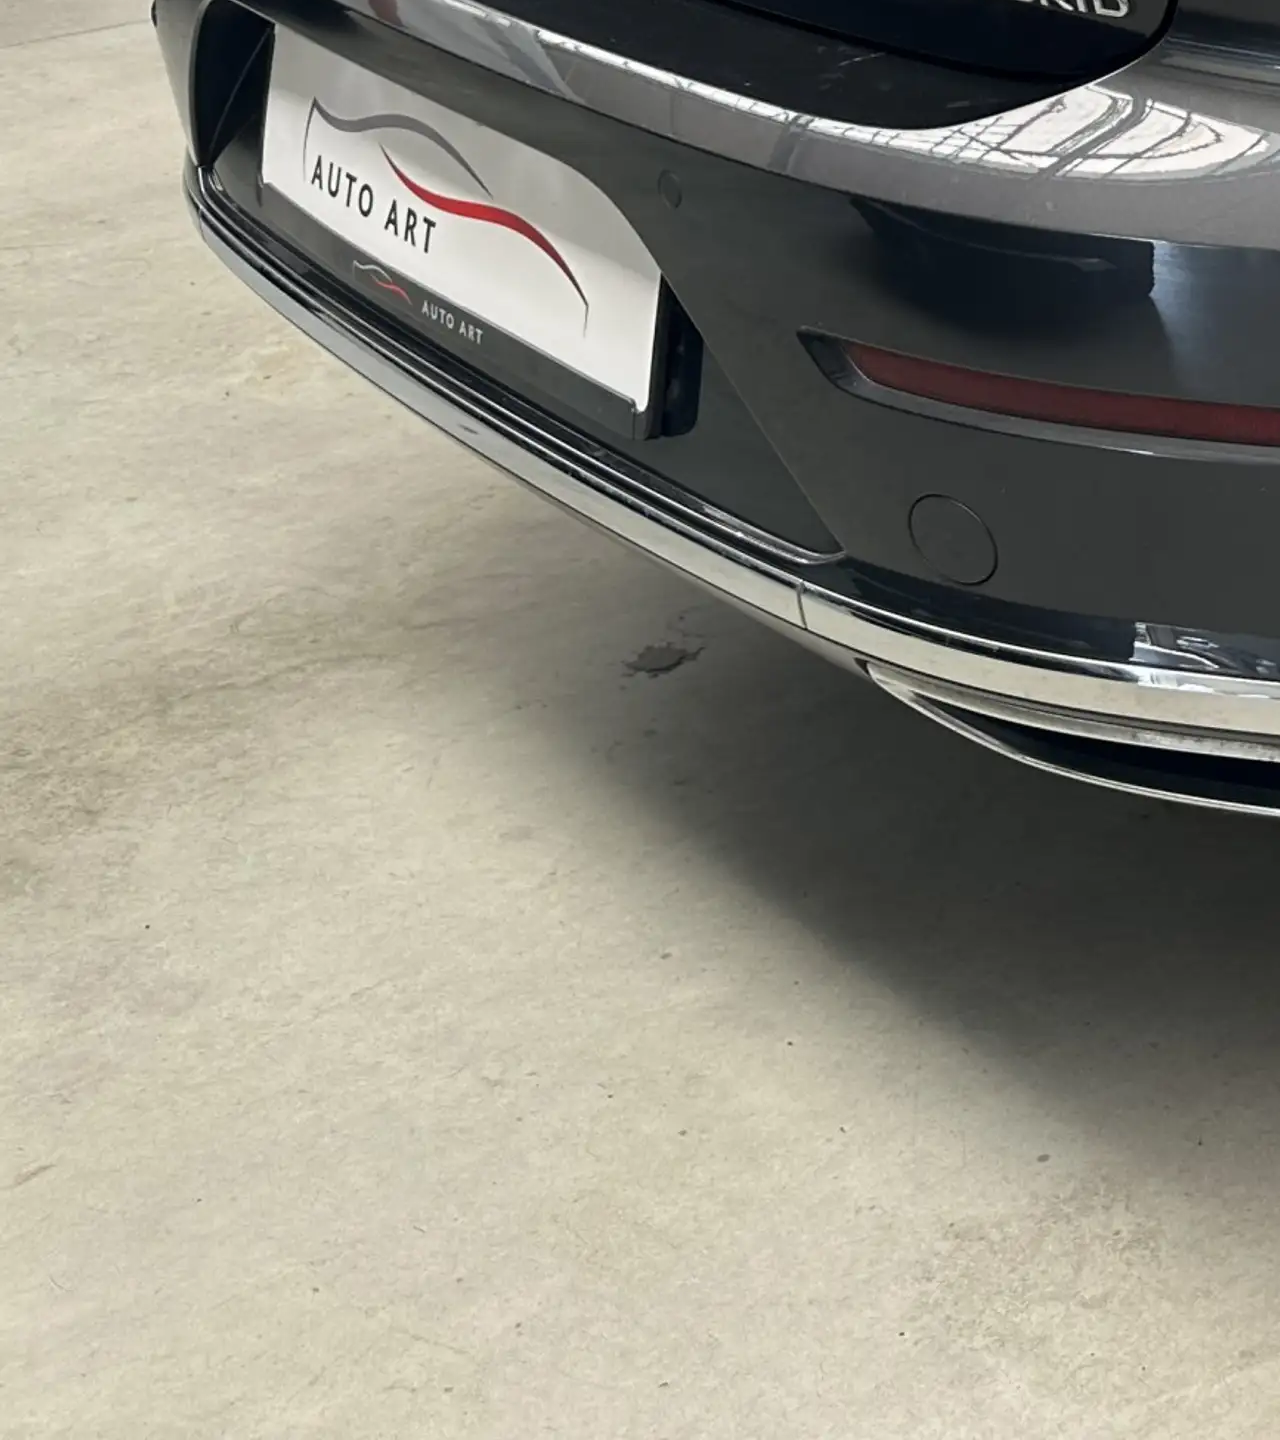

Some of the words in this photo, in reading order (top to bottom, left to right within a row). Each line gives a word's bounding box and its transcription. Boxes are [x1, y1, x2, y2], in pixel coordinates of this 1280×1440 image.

[311, 154, 374, 218] AUTO
[384, 198, 437, 254] ART
[421, 299, 455, 329] AUTO
[458, 320, 484, 345] ART
